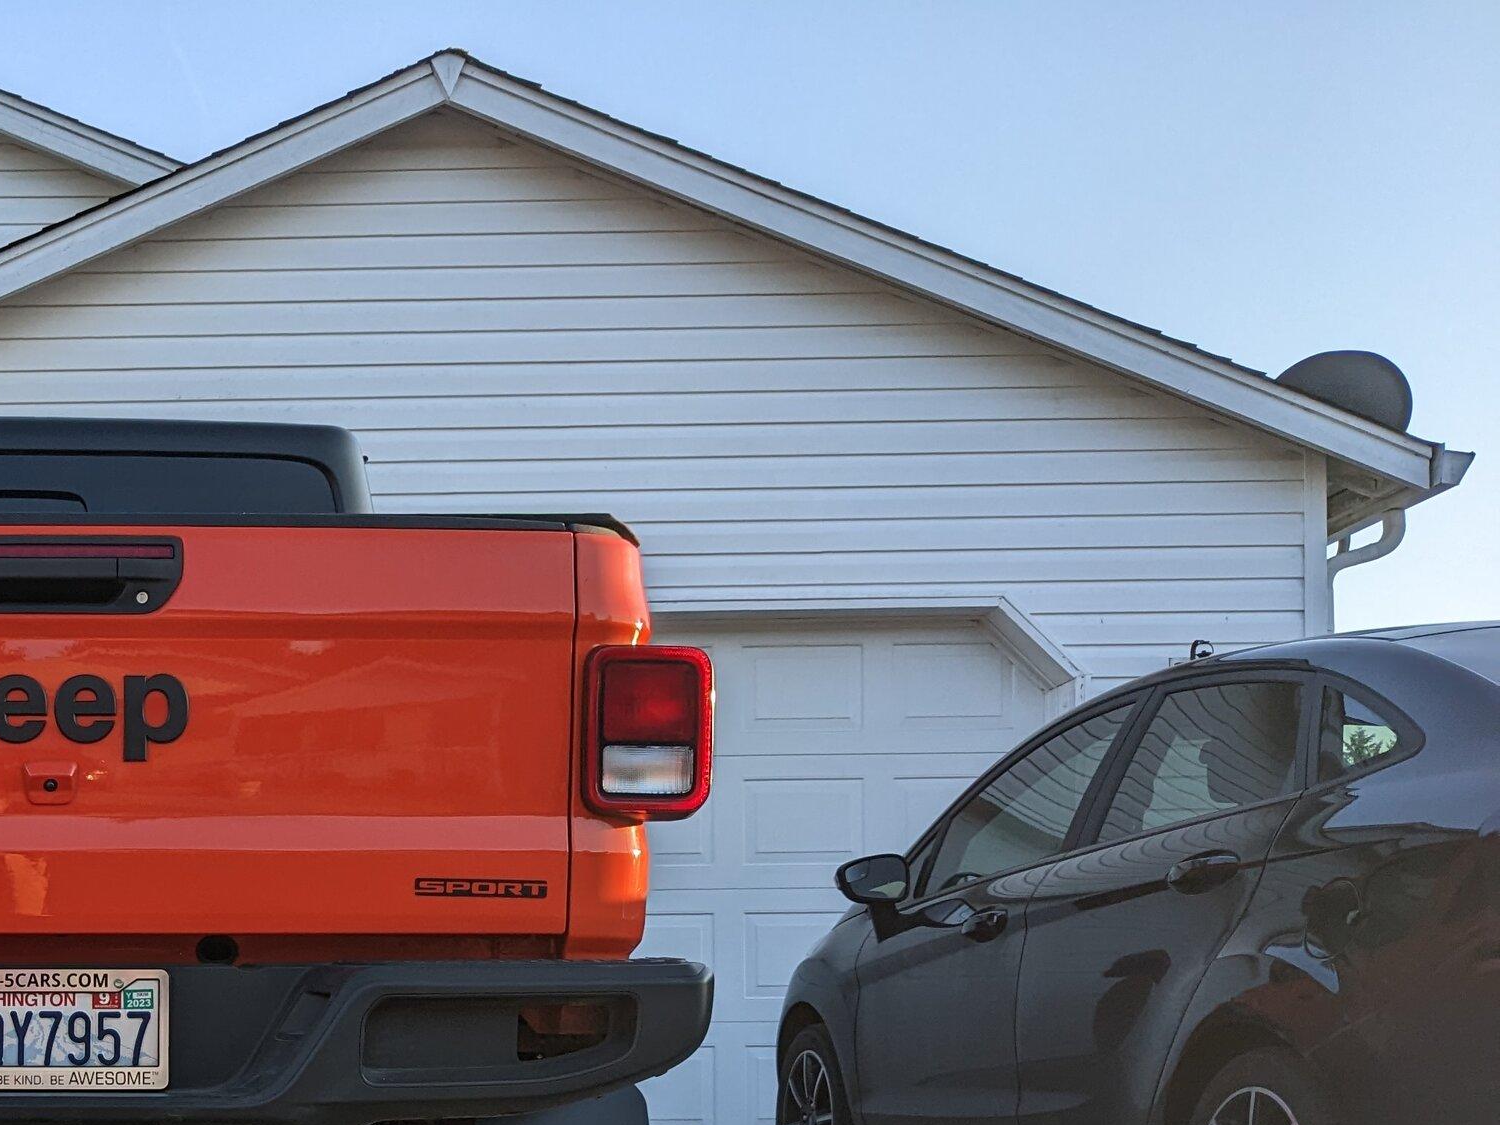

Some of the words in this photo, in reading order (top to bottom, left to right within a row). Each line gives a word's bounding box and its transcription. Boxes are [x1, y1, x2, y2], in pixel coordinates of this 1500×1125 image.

[414, 878, 548, 898] SPORT
[98, 992, 110, 1005] 9
[127, 999, 151, 1008] 2023
[13, 1074, 44, 1086] KIND.
[50, 1074, 65, 1086] BE
